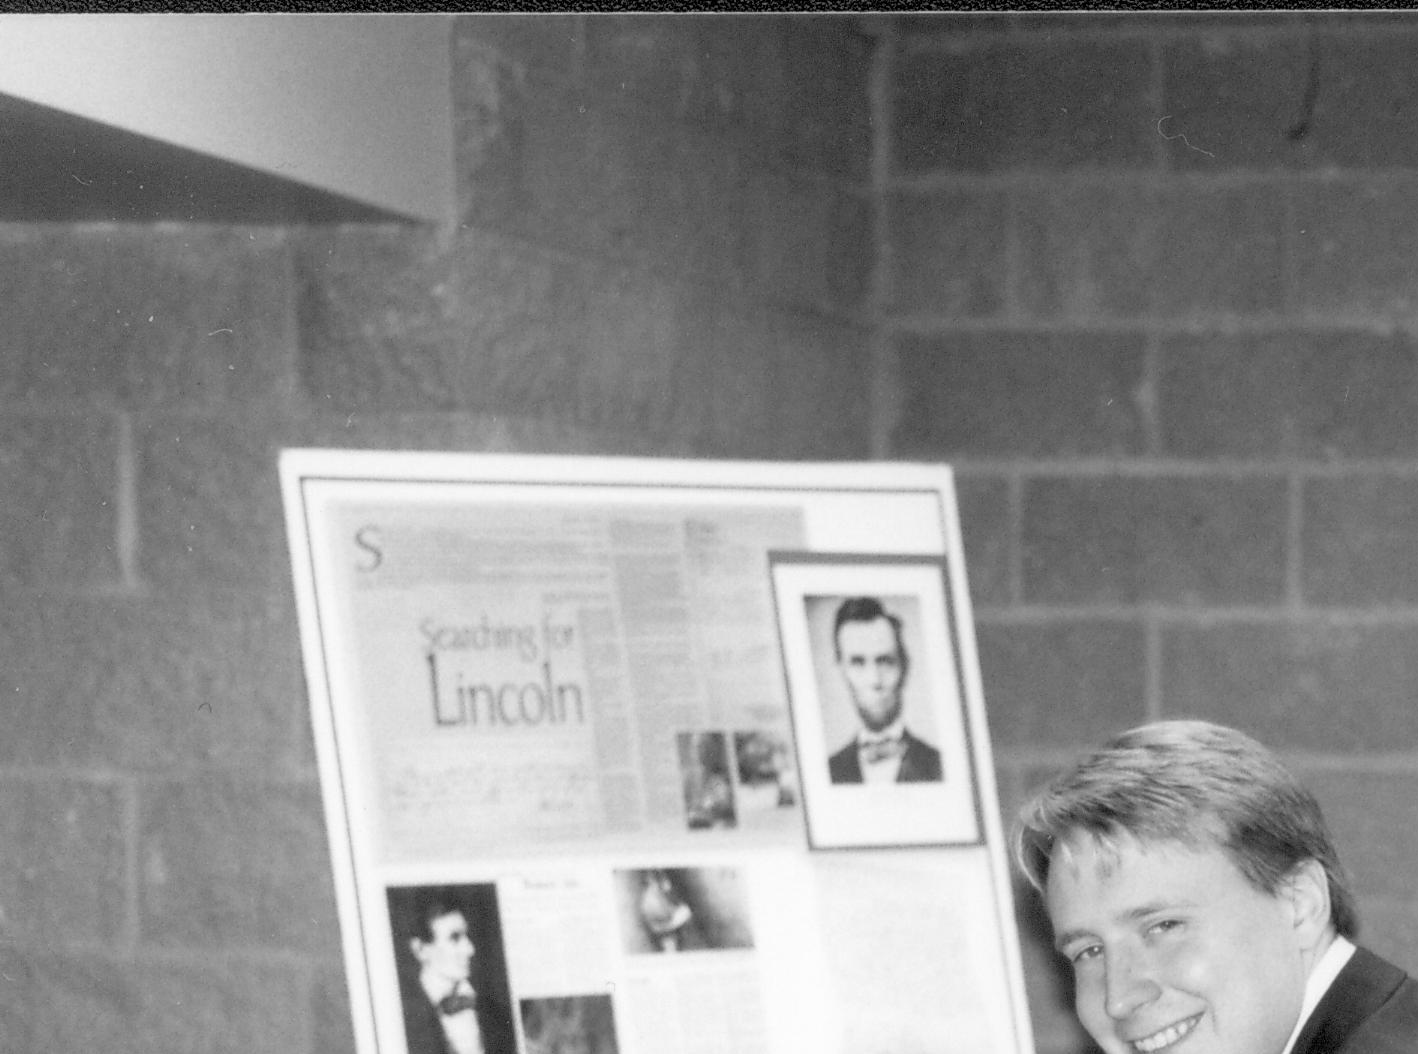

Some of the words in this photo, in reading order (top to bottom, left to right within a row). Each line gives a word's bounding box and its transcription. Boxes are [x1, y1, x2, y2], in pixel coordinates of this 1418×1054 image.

[354, 524, 383, 573] S
[419, 612, 537, 662] Searching
[541, 613, 574, 653] for
[426, 653, 584, 727] Lincoln
